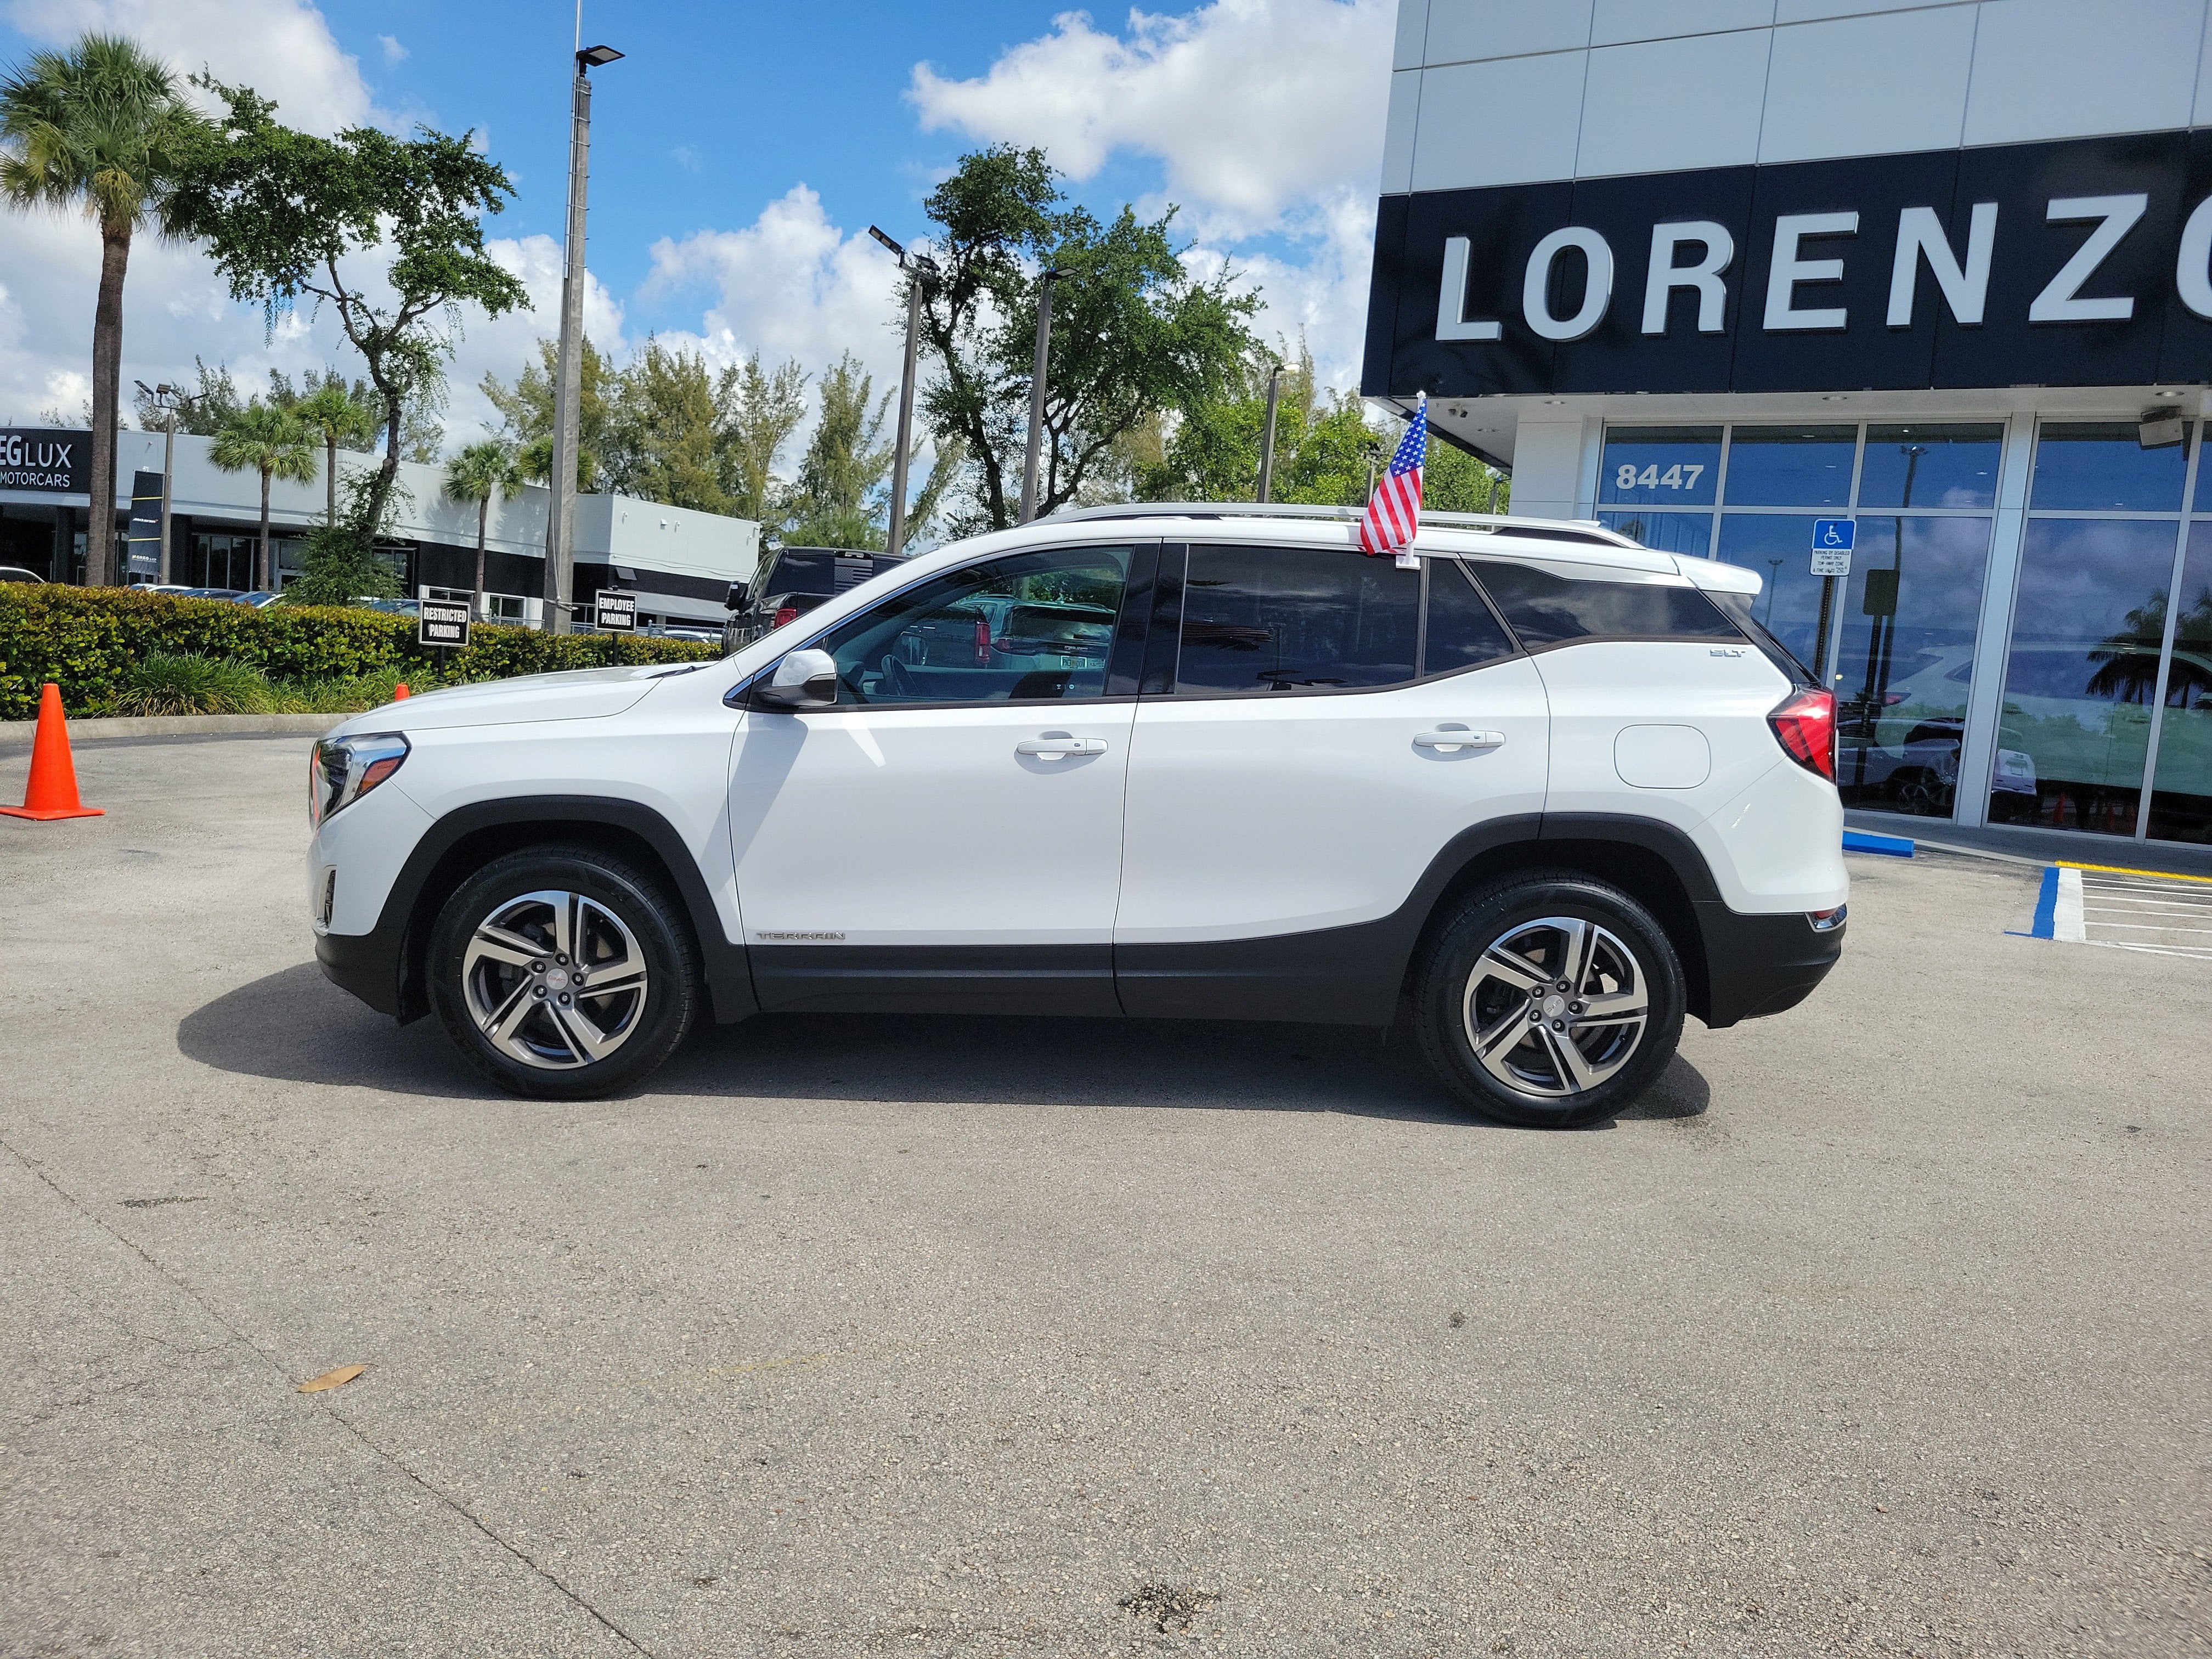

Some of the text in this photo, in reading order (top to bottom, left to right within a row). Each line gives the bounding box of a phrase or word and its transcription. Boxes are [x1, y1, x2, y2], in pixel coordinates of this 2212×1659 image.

[0, 471, 70, 488] MOTORCARS
[1616, 464, 1704, 489] 8447
[599, 597, 634, 612] EMPLOYEE
[424, 607, 467, 623] RESTRICTED
[601, 612, 631, 625] PARKING
[429, 624, 460, 638] PARKING
[1710, 648, 1746, 657] SLT
[757, 932, 845, 940] TERRAIN
